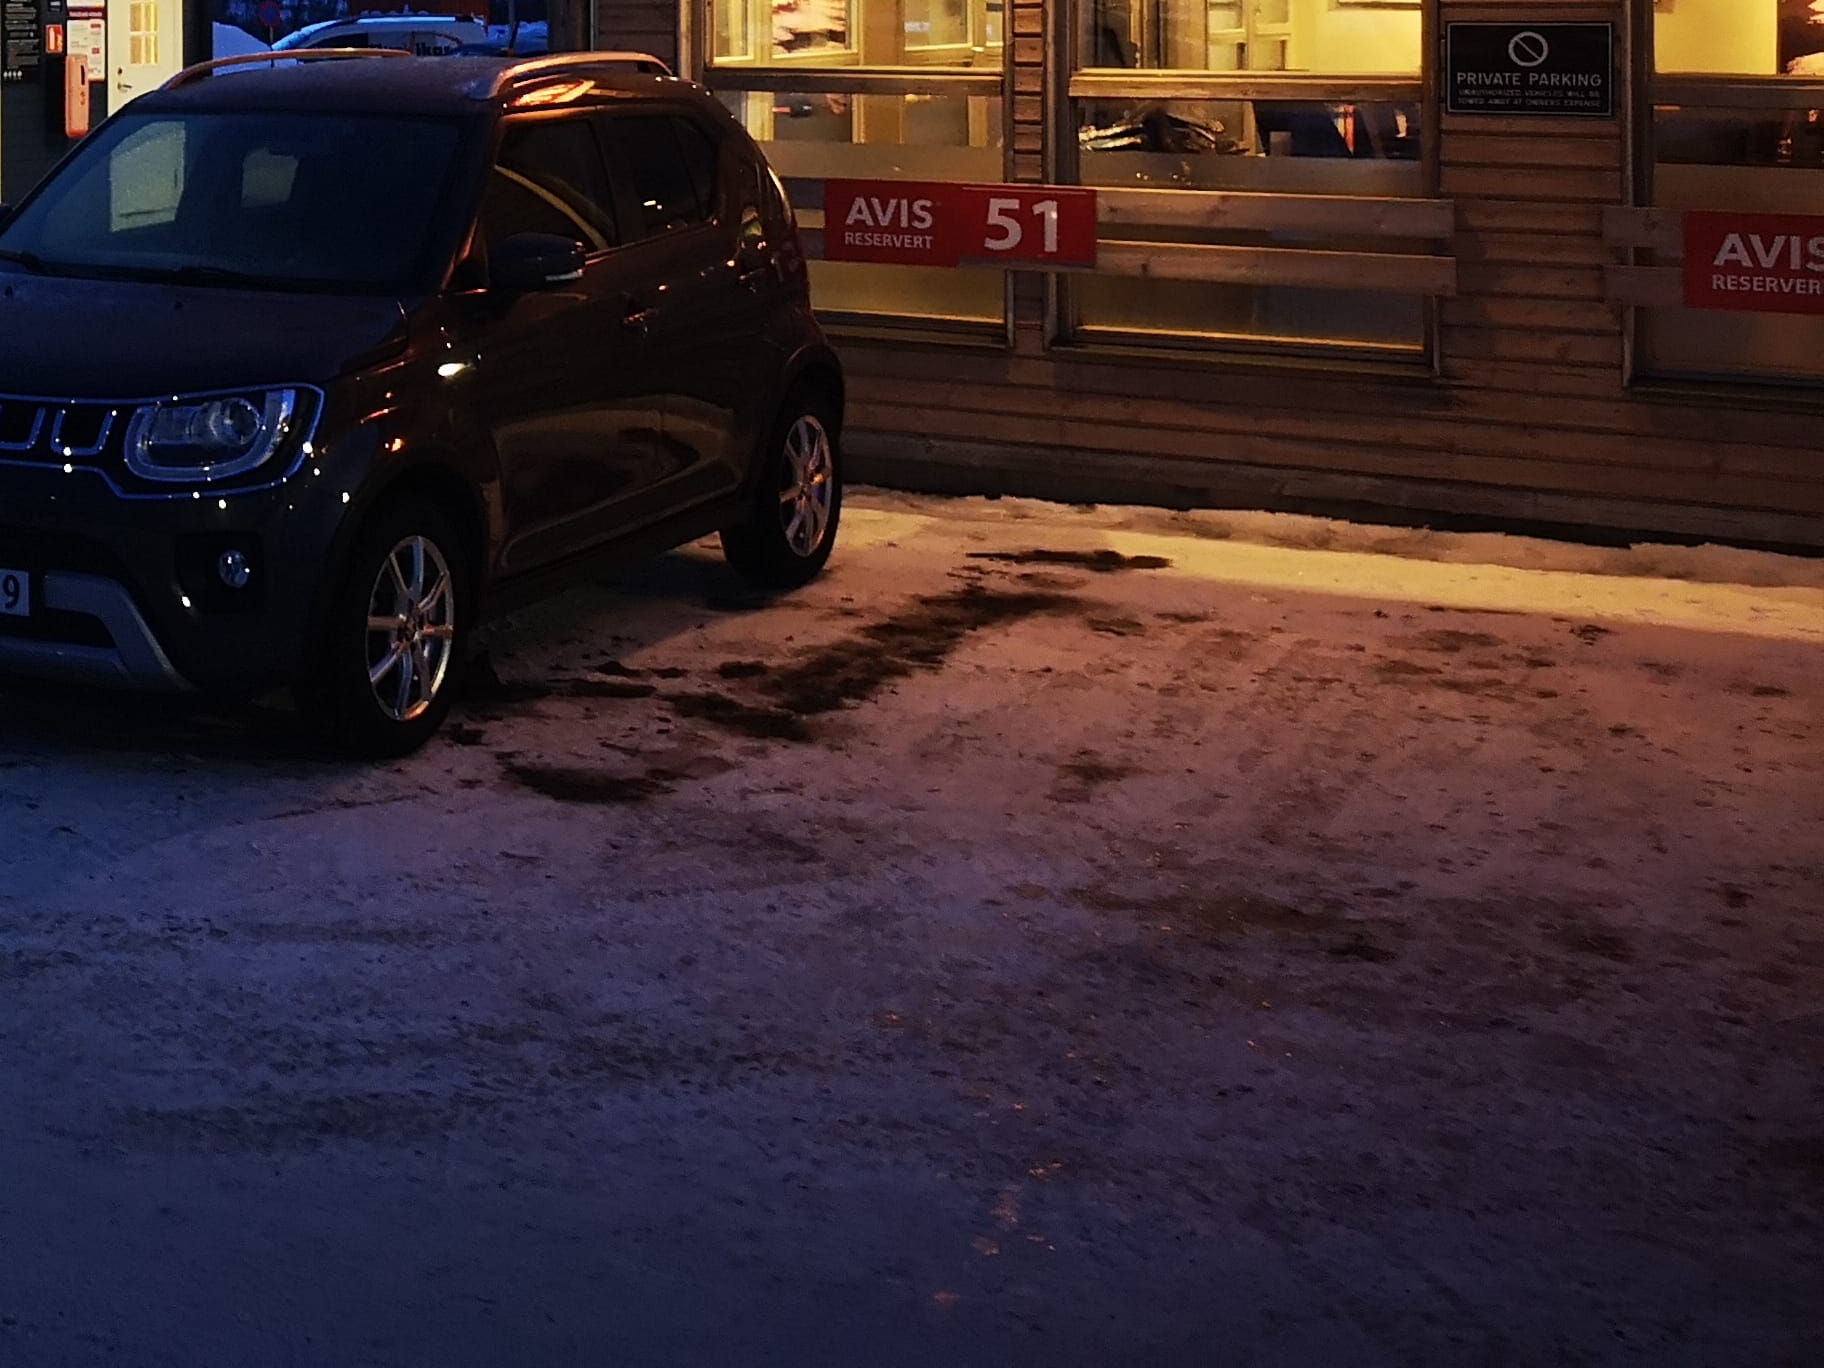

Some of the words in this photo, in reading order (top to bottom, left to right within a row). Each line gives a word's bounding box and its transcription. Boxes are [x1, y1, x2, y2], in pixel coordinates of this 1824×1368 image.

[1456, 72, 1521, 85] PRIVATE
[1529, 73, 1602, 87] PARKING
[845, 197, 933, 229] AVIS
[984, 197, 1058, 253] 51
[844, 232, 933, 249] RESERVERT
[1712, 232, 1824, 272] AVIS
[1712, 274, 1824, 295] RESERVER
